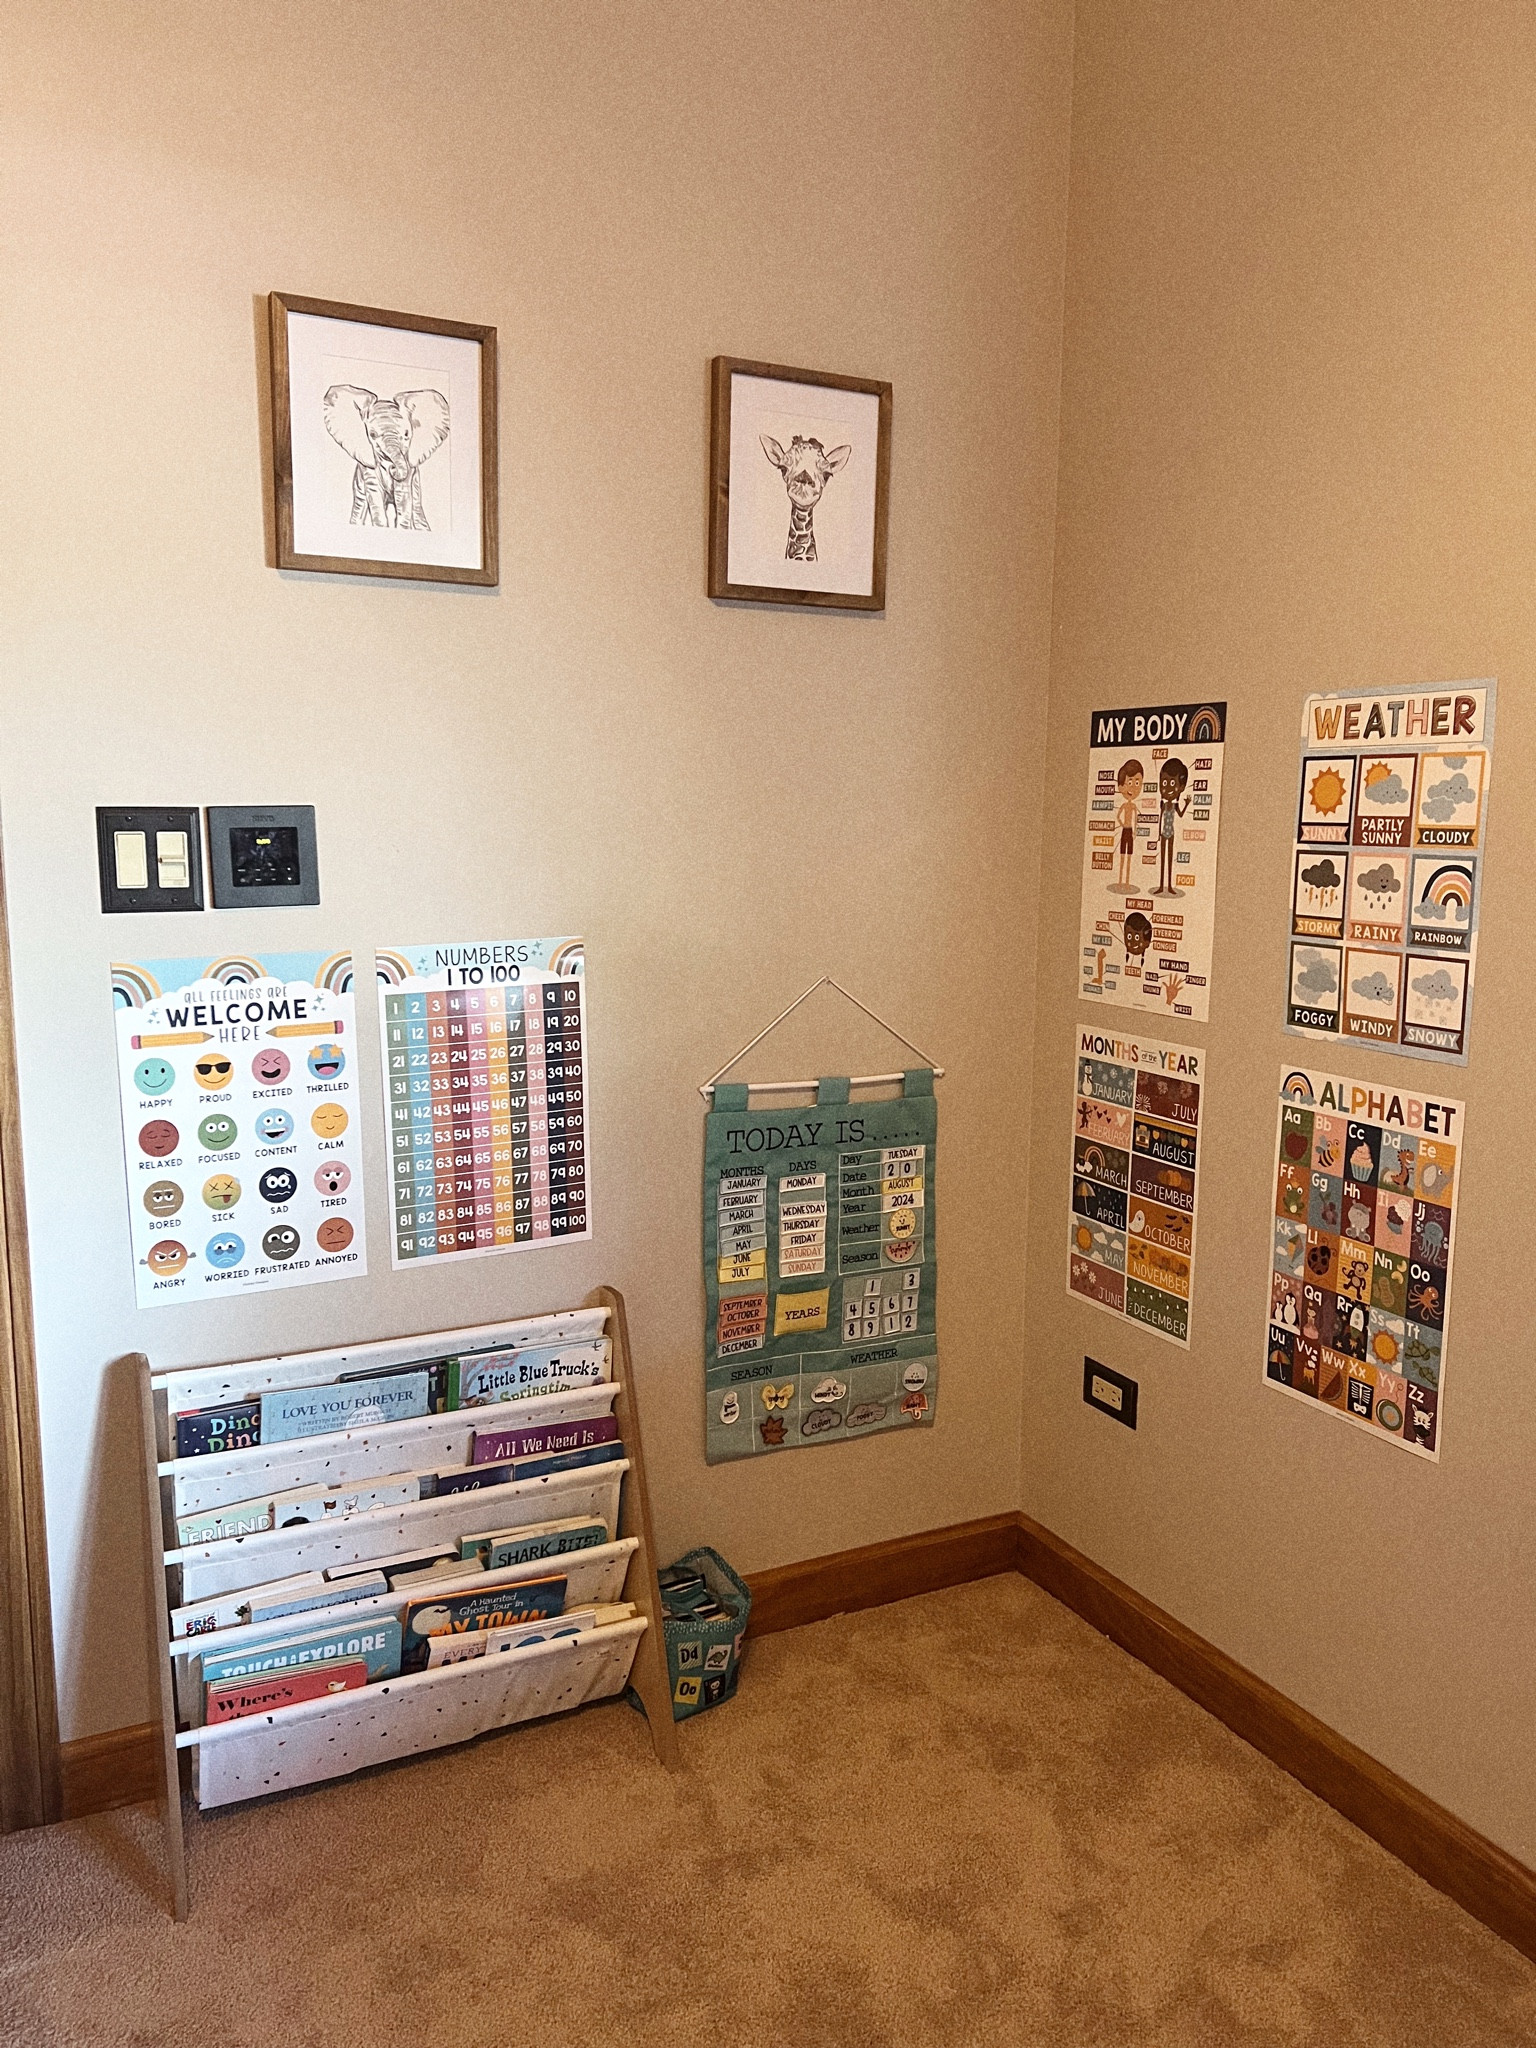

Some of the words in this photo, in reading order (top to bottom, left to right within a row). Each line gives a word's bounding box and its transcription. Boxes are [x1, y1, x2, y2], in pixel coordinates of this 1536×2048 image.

[1314, 695, 1476, 739] WEATHER
[1097, 718, 1126, 743] MY
[1133, 714, 1188, 742] BODY
[1153, 749, 1167, 758] FACE
[1196, 760, 1211, 769] HAIR
[1099, 771, 1113, 780] NOSE
[1097, 786, 1114, 794] MOUTH
[1194, 781, 1207, 789] EAR
[1194, 795, 1211, 804] PALM
[1194, 810, 1209, 819] ARM
[1090, 822, 1114, 830] STOMACH
[1361, 818, 1404, 832] PARTLY
[1304, 826, 1345, 841] SUNNY
[1361, 831, 1402, 844] SUNNY
[1422, 831, 1470, 844] CLOUDY
[1178, 853, 1190, 862] LEG
[1177, 876, 1194, 885] FOOT
[1127, 900, 1135, 908] MY
[1137, 900, 1152, 909] HEAD
[1153, 916, 1183, 925] FOREHEAD
[1299, 921, 1339, 934] STORMY
[1354, 925, 1399, 941] RAINY
[1414, 931, 1462, 946] RAINBOW
[435, 945, 528, 967] NUMBERS
[448, 969, 452, 985] 1
[460, 967, 484, 984] TO
[490, 965, 520, 982] 100
[210, 987, 262, 1002] FEELINGS
[393, 1003, 398, 1014] 1
[411, 1002, 420, 1013] 2
[432, 1000, 440, 1012] 3
[451, 999, 460, 1010] 4
[470, 997, 479, 1009] 5
[489, 996, 498, 1007] 6
[510, 994, 517, 1006] 7
[528, 993, 536, 1004] 8
[547, 991, 555, 1003] 9
[564, 990, 576, 1002] 10
[165, 999, 307, 1028] WELCOME
[1294, 1009, 1334, 1027] FOGGY
[219, 1026, 260, 1043] HERE
[1350, 1019, 1392, 1038] WINDY
[1408, 1028, 1456, 1048] SNOWY
[1081, 1033, 1139, 1063] MONTHS
[1159, 1050, 1198, 1076] YEAR
[252, 1088, 293, 1099] EXCITED
[306, 1083, 349, 1093] THRILLED
[1093, 1084, 1133, 1104] JANUARY
[139, 1099, 173, 1109] HAPPY
[199, 1093, 232, 1104] PROUD
[1172, 1103, 1198, 1122] JULY
[1319, 1080, 1456, 1137] ALPHABET
[1284, 1109, 1301, 1125] Aa
[1316, 1116, 1331, 1131] Bb
[727, 1123, 824, 1154] TODAY
[1087, 1123, 1130, 1143] FEBRUARY
[1349, 1123, 1364, 1141] Cc
[1383, 1130, 1400, 1148] Dd
[254, 1145, 297, 1157] CONTENT
[318, 1141, 344, 1150] CALM
[1419, 1141, 1436, 1158] Ee
[198, 1152, 241, 1164] FOCUSED
[842, 1154, 862, 1166] Day
[888, 1148, 918, 1159] TUESDAY
[1153, 1142, 1194, 1165] AUGUST
[139, 1159, 183, 1170] RELAXED
[720, 1165, 764, 1177] MONTHS
[789, 1161, 817, 1172] DAYS
[842, 1171, 867, 1182] Date
[888, 1164, 895, 1177] 2
[1095, 1165, 1127, 1186] MARCH
[727, 1178, 762, 1189] JANUARY
[786, 1176, 817, 1188] MONDAY
[842, 1186, 874, 1197] Month
[888, 1178, 915, 1190] AUGUST
[722, 1194, 758, 1206] FEBRUARY
[1135, 1180, 1193, 1209] SEPTEMBER
[320, 1197, 347, 1208] TIRED
[782, 1204, 826, 1215] WEDNESDAY
[842, 1202, 866, 1212] Year
[891, 1194, 914, 1207] 2024
[271, 1205, 289, 1215] SAD
[729, 1209, 754, 1220] MARCH
[149, 1219, 181, 1230] BORED
[212, 1213, 235, 1223] SICK
[515, 1223, 530, 1235] 97
[552, 1218, 567, 1229] 99
[569, 1214, 586, 1227] 100
[783, 1218, 820, 1231] THURSDAY
[1097, 1207, 1125, 1229] APRIL
[732, 1224, 753, 1235] APRIL
[842, 1222, 880, 1234] Weather
[736, 1239, 752, 1249] MAY
[791, 1234, 817, 1244] FRIDAY
[1145, 1223, 1190, 1251] OCTOBER
[732, 1253, 751, 1263] JUNE
[784, 1247, 822, 1259] SATURDAY
[842, 1251, 879, 1263] Season
[1105, 1250, 1124, 1266] MAY
[254, 1259, 310, 1276] FRUSTRATED
[314, 1254, 358, 1267] ANNOYED
[788, 1261, 816, 1272] SUNDAY
[205, 1270, 249, 1283] WORRIED
[732, 1267, 750, 1278] JULY
[1133, 1261, 1188, 1294] NOVEMBER
[153, 1278, 186, 1289] ANGRY
[722, 1298, 762, 1311] SEPTEMBER
[1098, 1286, 1123, 1309] JUNE
[727, 1309, 760, 1322] OCTOBER
[785, 1307, 821, 1321] YEARS
[1134, 1300, 1186, 1337] DECEMBER
[722, 1324, 761, 1338] NOVEMBER
[722, 1339, 758, 1354] DECEMBER
[850, 1349, 898, 1363] WEATHER
[478, 1370, 515, 1394] Little
[519, 1365, 548, 1383] Blue
[550, 1359, 599, 1377] Truck's
[731, 1365, 772, 1380] SEASON
[282, 1405, 317, 1419] LOVE
[322, 1400, 351, 1413] YOU
[355, 1390, 413, 1408] FOREVER
[495, 1441, 515, 1458] All
[522, 1438, 542, 1453] We
[547, 1434, 578, 1450] Need
[582, 1430, 594, 1444] Is
[498, 1542, 552, 1567] SHARK
[480, 1593, 517, 1605] Haunted
[459, 1605, 490, 1616] Ghost
[493, 1602, 512, 1611] Tour
[186, 1616, 217, 1630] ERIC
[299, 1632, 386, 1663] EXPLORE
[681, 1647, 698, 1663] Dd
[679, 1682, 697, 1696] Oo
[217, 1688, 293, 1712] Where's
